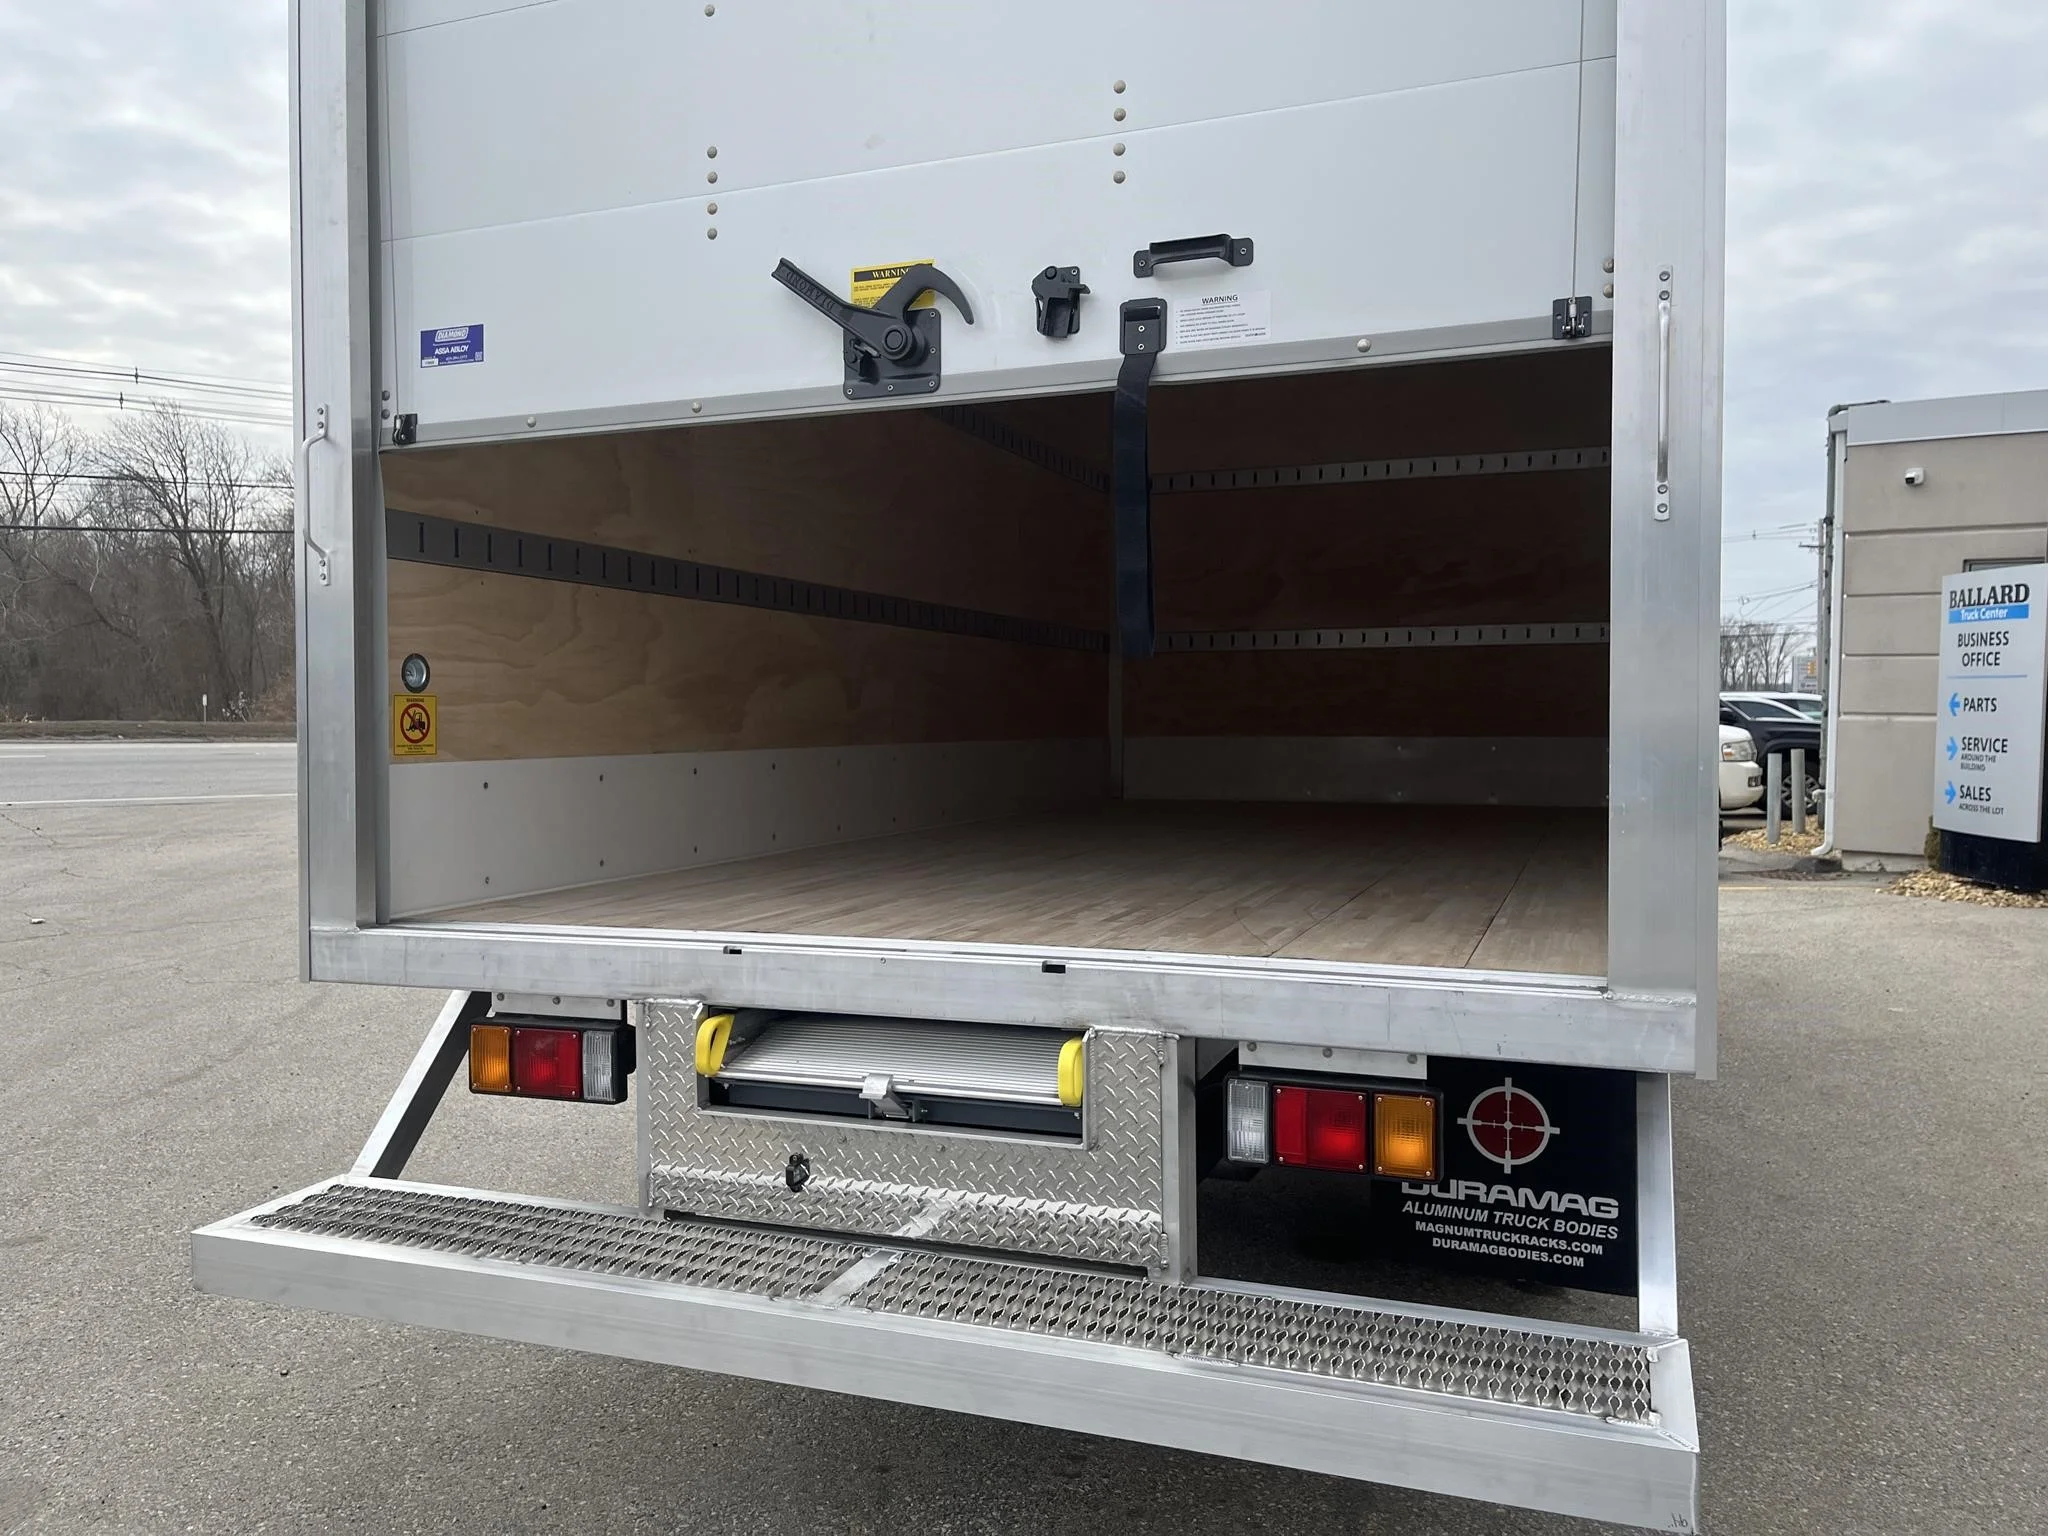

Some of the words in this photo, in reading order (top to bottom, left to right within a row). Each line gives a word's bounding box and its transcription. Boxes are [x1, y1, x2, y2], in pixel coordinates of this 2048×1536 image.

[872, 267, 909, 279] WARNIN
[1202, 294, 1238, 304] WARNING
[1949, 583, 2030, 609] BALLARD
[1960, 609, 1978, 620] Truck
[1980, 608, 2008, 619] Center
[1957, 631, 2010, 648] BUSINESS
[1962, 651, 2001, 667] OFFICE
[1963, 697, 1997, 712] PARTS
[1961, 736, 2009, 753] SERVICE
[1961, 753, 1984, 762] AROUND
[1985, 755, 1997, 763] THE
[1960, 762, 1986, 772] BUILDING
[1959, 784, 1992, 802] SALES
[1959, 803, 1979, 812] ACROSS
[1979, 805, 1991, 814] THE
[1992, 807, 2004, 815] LOT
[1401, 1179, 1619, 1219] DURAMAG
[1402, 1200, 1489, 1223] ALUMINUM
[1493, 1210, 1551, 1231] TRUCK
[1553, 1219, 1619, 1240] BODIES
[1415, 1220, 1603, 1255] MAGNUMTRUCKRACKS.COM
[1432, 1237, 1585, 1267] DURAMAGBODIES.COM
